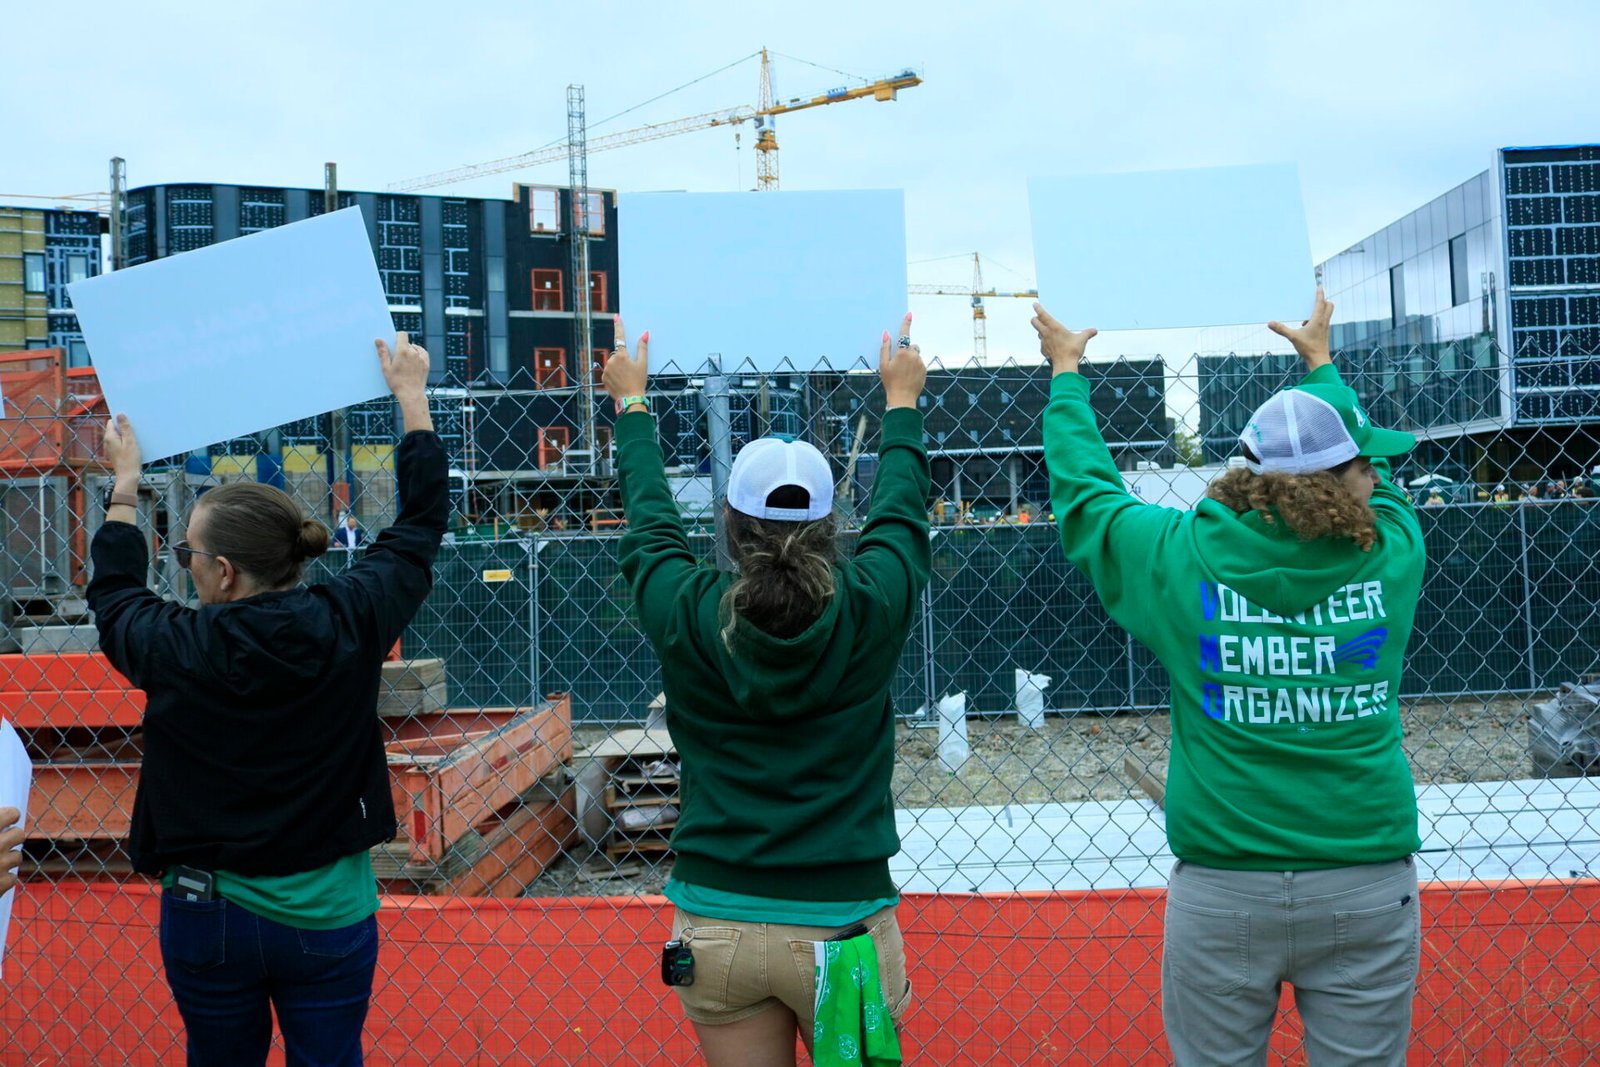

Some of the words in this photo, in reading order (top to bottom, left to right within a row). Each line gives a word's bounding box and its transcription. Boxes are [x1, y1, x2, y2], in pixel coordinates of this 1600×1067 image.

[1200, 580, 1386, 626] VOLEER
[1199, 634, 1336, 675] MEMBER
[1202, 680, 1389, 724] ORGANIZER
